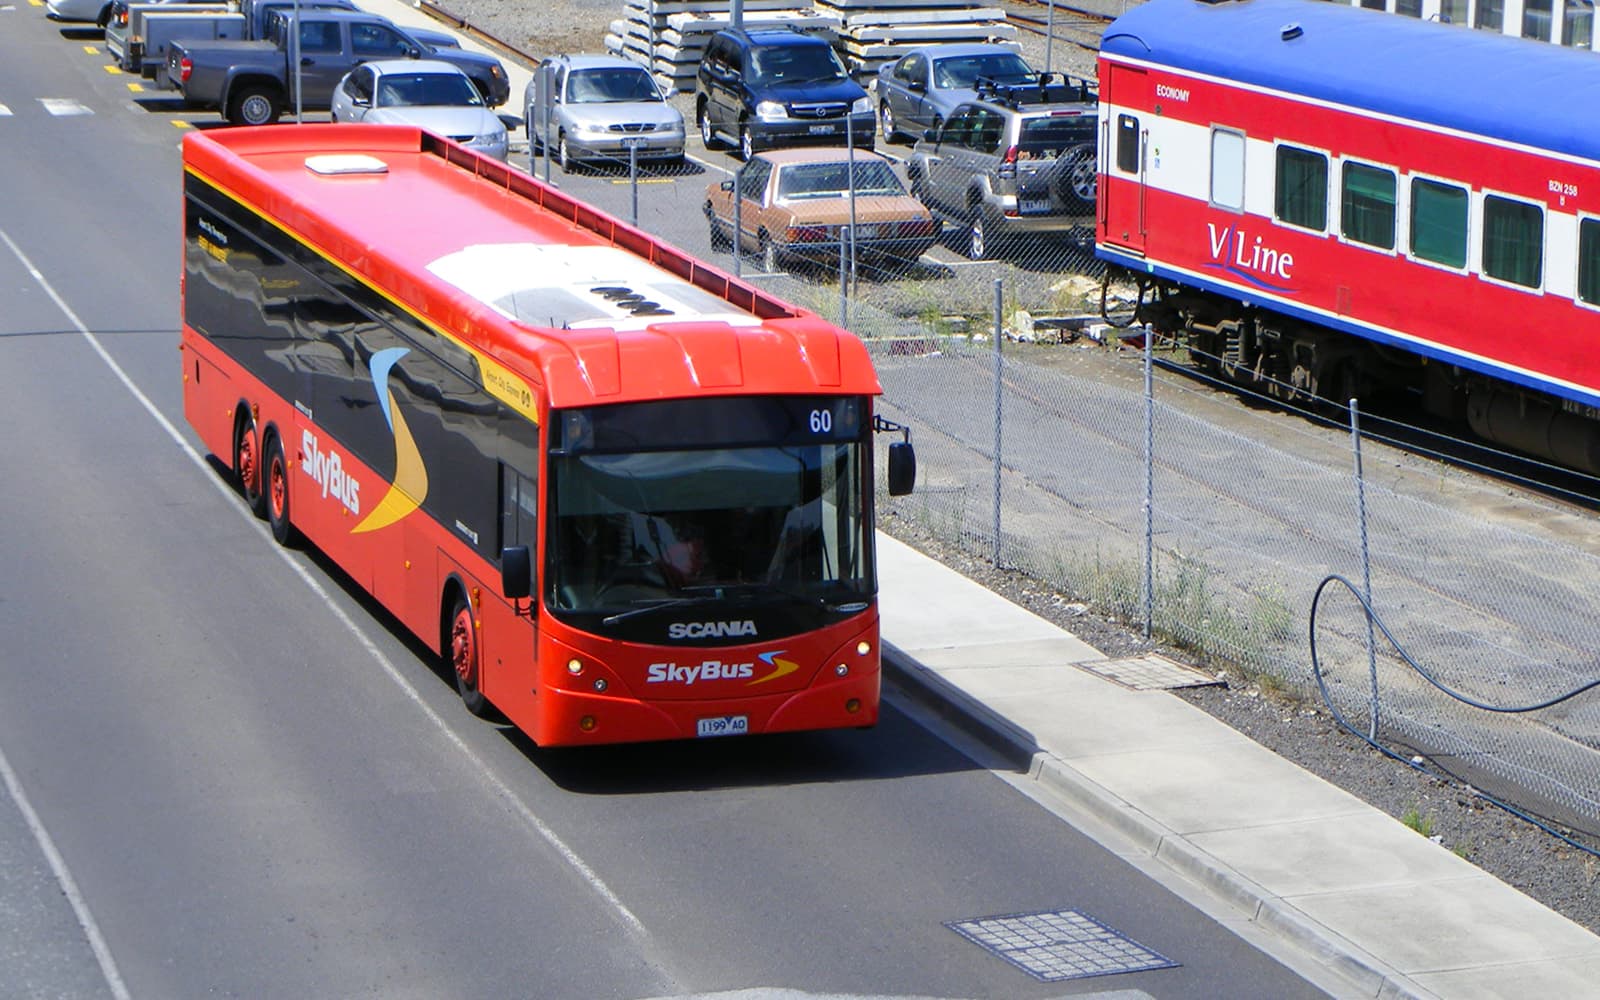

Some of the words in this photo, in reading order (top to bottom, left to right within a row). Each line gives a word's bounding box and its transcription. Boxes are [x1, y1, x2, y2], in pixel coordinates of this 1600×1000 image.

[1156, 84, 1190, 103] ECONOMY
[810, 409, 832, 433] 60
[302, 429, 360, 515] SkyBus
[669, 620, 758, 639] SCANIA
[646, 660, 754, 685] SkyBus
[702, 721, 726, 732] 1199
